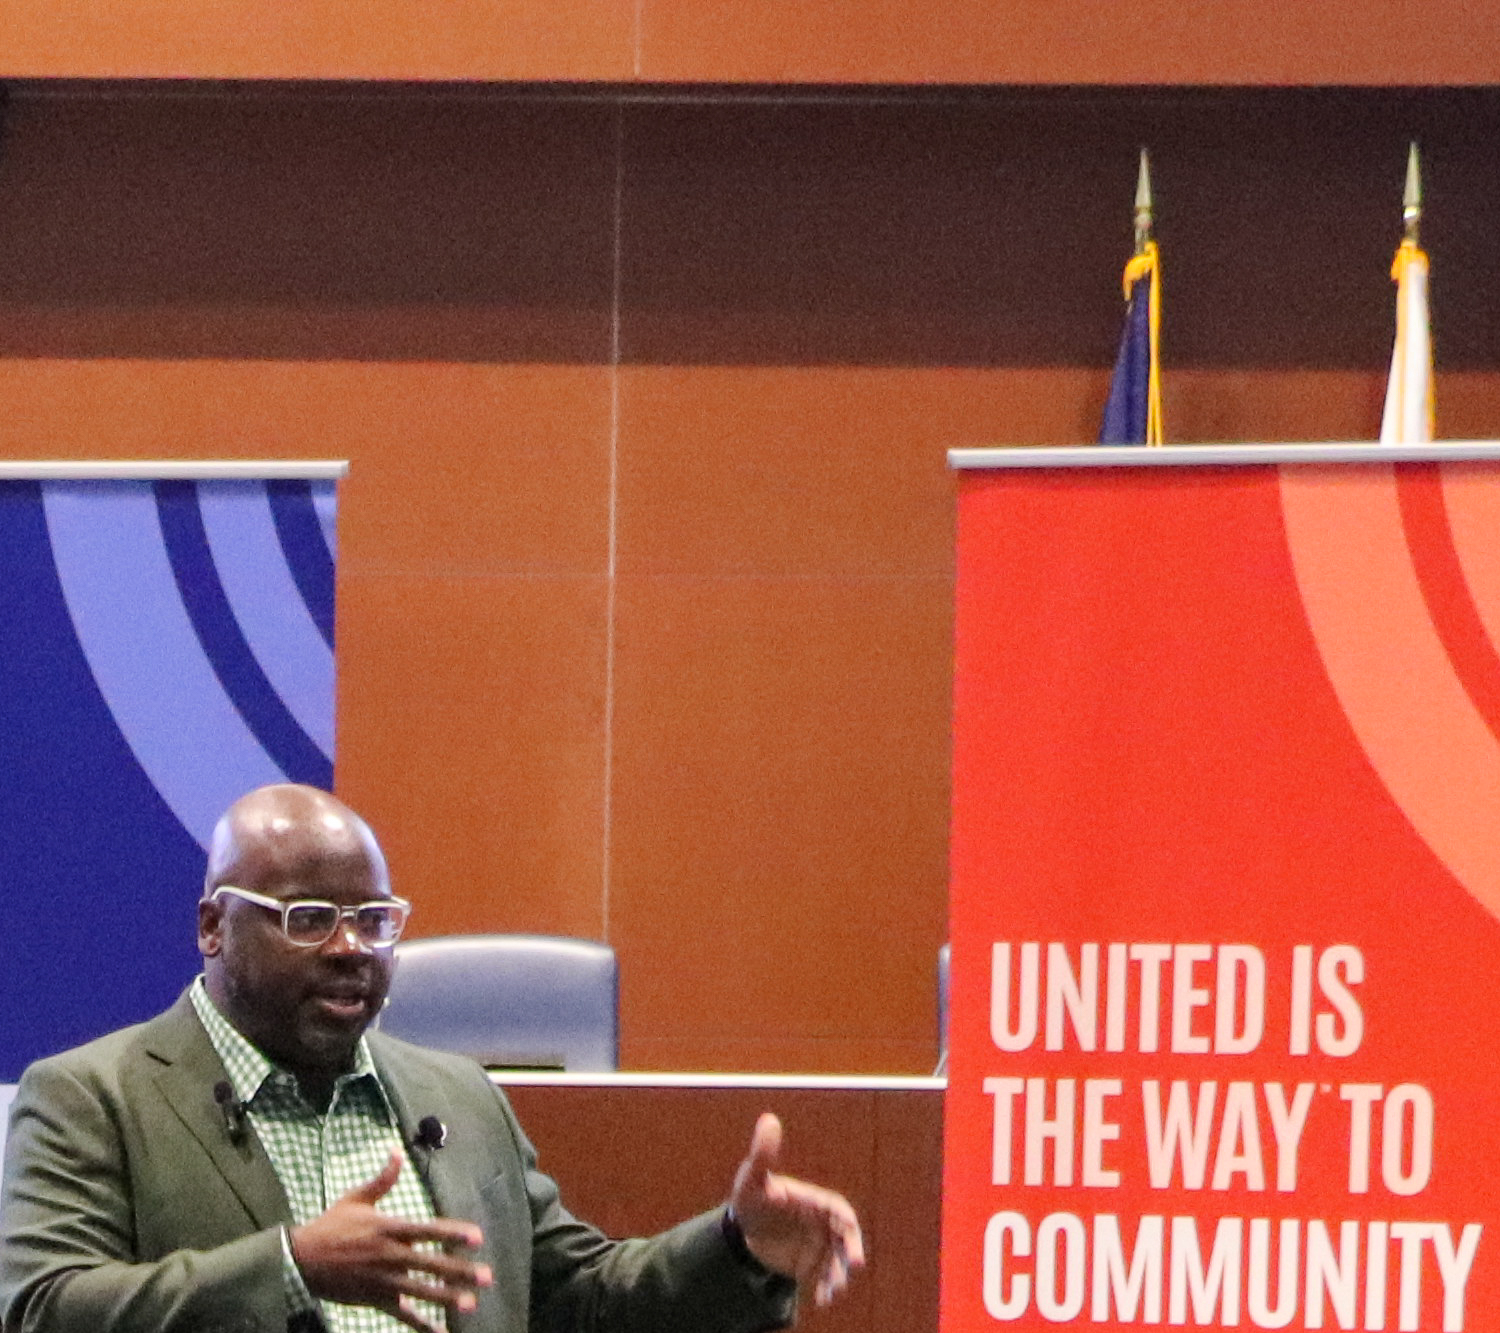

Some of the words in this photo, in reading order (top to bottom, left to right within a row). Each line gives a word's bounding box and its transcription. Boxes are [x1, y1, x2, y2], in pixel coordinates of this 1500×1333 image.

[990, 943, 1265, 1054] UNITED
[1290, 945, 1364, 1057] IS
[983, 1077, 1122, 1187] THE
[1340, 1083, 1433, 1195] TO
[983, 1211, 1482, 1333] COMMUNITY
